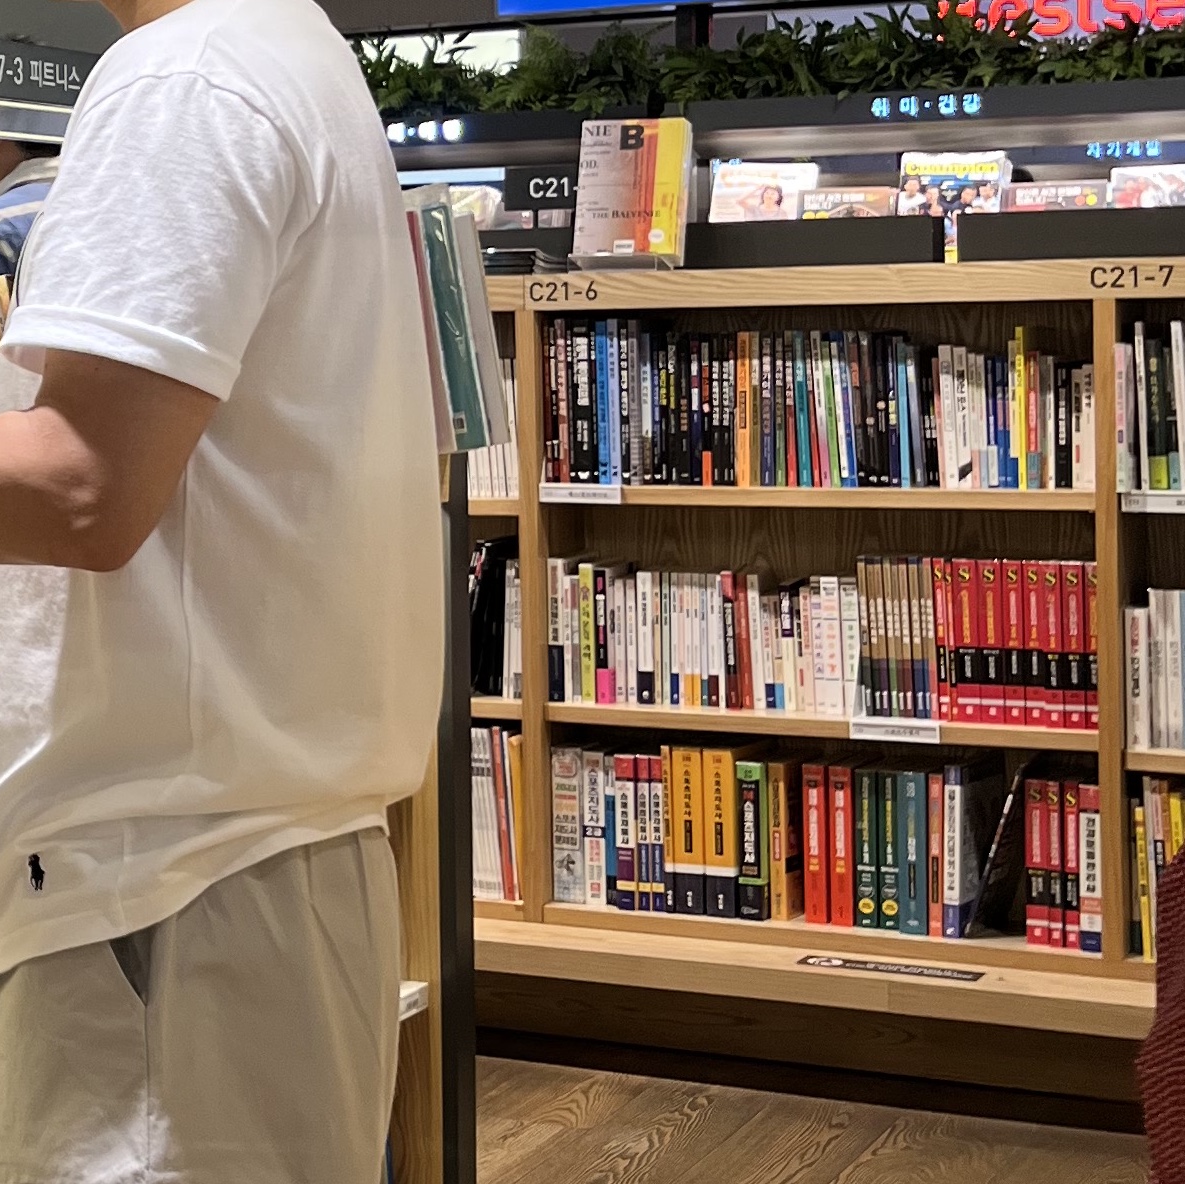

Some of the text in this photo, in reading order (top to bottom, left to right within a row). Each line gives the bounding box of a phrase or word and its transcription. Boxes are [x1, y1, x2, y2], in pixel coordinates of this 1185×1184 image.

[30, 60, 81, 90] 피트니스
[620, 125, 645, 150] B
[612, 210, 660, 219] BALVENIE
[1090, 265, 1175, 289] C21-7
[529, 281, 598, 302] C21-6
